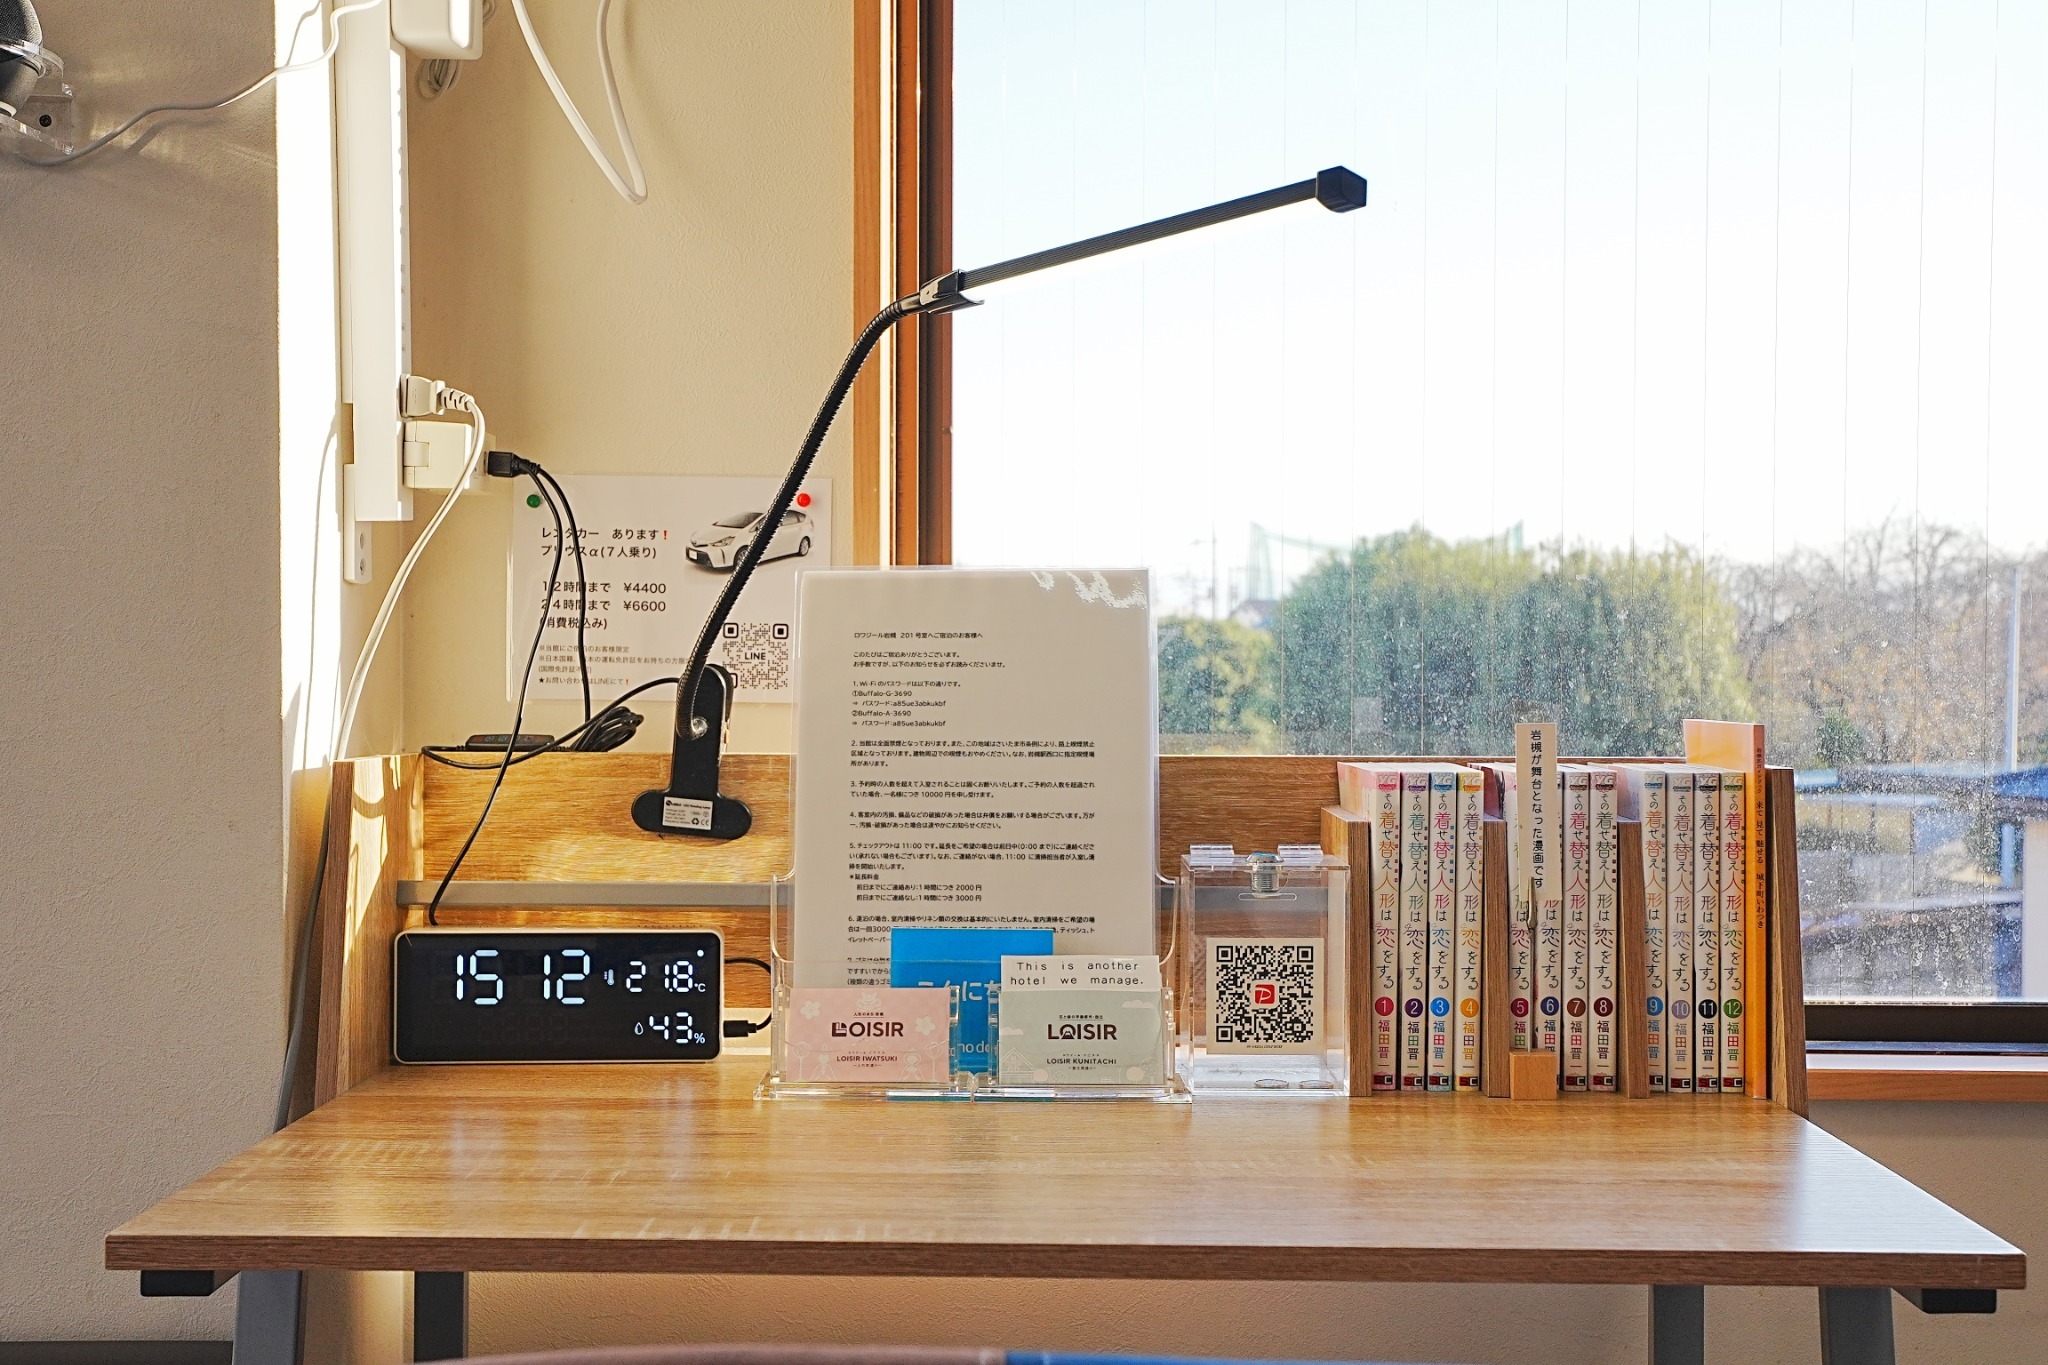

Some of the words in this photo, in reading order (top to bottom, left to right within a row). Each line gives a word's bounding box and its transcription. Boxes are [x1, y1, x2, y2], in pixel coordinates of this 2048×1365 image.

[623, 582, 667, 594] ¥4400
[623, 600, 667, 612] ¥6600
[744, 651, 767, 661] LINE
[1375, 793, 1397, 989] その着せ替え人形は恋をする
[1405, 794, 1426, 990] その着せ替え人形は恋をする
[1430, 793, 1453, 989] その着せ替え人形は恋をする
[1460, 794, 1482, 990] その着せ替え人形は恋をする
[1565, 793, 1587, 990] その着せ替え人形は恋をする
[1592, 793, 1616, 990] その着せ替え人形は恋をする
[1645, 791, 1665, 989] その着せ替え人形は恋をする
[1670, 795, 1691, 991] その着せ替え人形は恋をする
[1697, 794, 1719, 991] その着せ替え人形は恋をする
[1722, 794, 1744, 991] その着せ替え人形は恋をする
[455, 949, 504, 1006] 15
[543, 949, 590, 1006] 12
[1010, 976, 1047, 986] hotel
[1060, 977, 1077, 985] we
[1090, 976, 1144, 989] manage.
[1016, 961, 1048, 972] This
[1061, 961, 1075, 971] is
[1087, 961, 1139, 972] another
[832, 1021, 904, 1038] LOISIR
[1047, 1023, 1118, 1041] LOISIR
[1378, 1020, 1390, 1067] 福田晋一
[1407, 1021, 1420, 1069] 福田晋一
[1433, 1020, 1446, 1068] 福田晋一
[1463, 1021, 1475, 1069] 福田晋一
[1570, 1020, 1583, 1067] 福田晋一
[1597, 1020, 1610, 1067] 福田晋一
[1648, 1020, 1660, 1067] 福田晋一
[1674, 1023, 1687, 1070] 福田晋一
[1702, 1022, 1714, 1069] 福田晋一
[1727, 1022, 1740, 1069] 福田晋一
